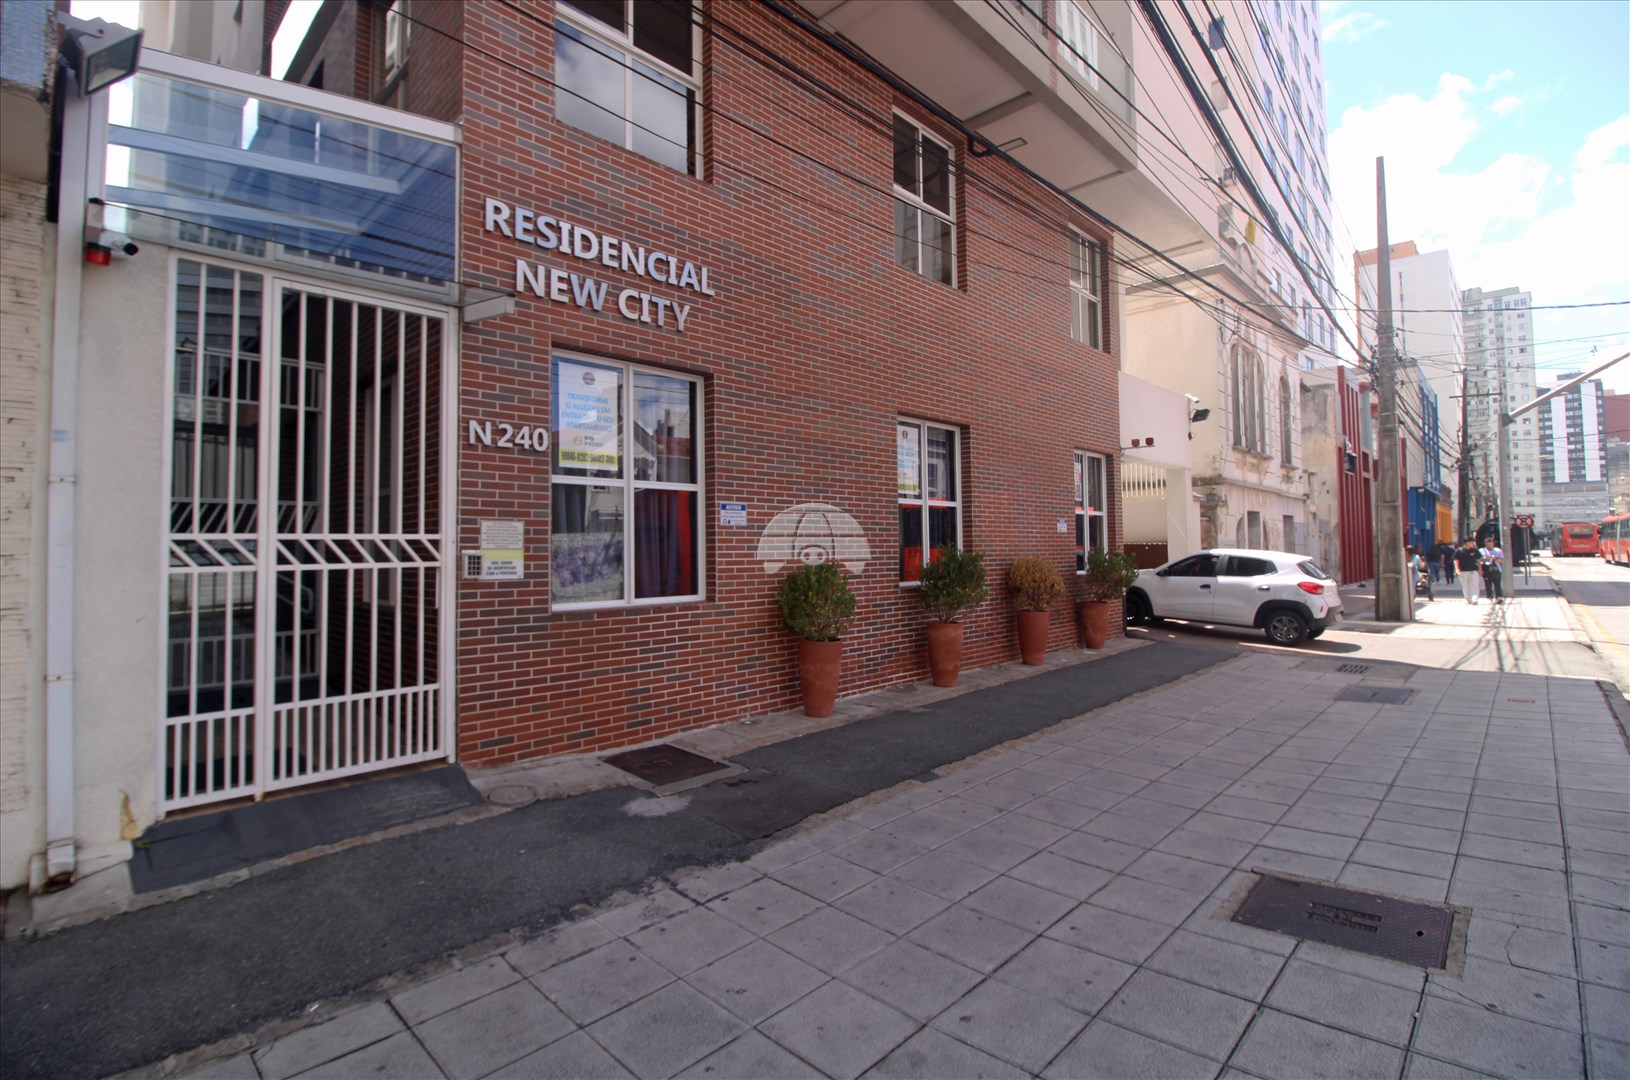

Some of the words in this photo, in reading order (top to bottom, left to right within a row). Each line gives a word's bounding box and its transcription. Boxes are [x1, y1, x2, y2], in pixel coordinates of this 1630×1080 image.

[484, 197, 715, 297] RESIDENCIAL
[516, 258, 608, 312] NEW
[617, 288, 690, 332] CITY
[568, 393, 608, 404] TRANSFORME
[469, 419, 492, 446] N
[497, 423, 549, 452] 240
[566, 422, 613, 432] APARTAMENTO
